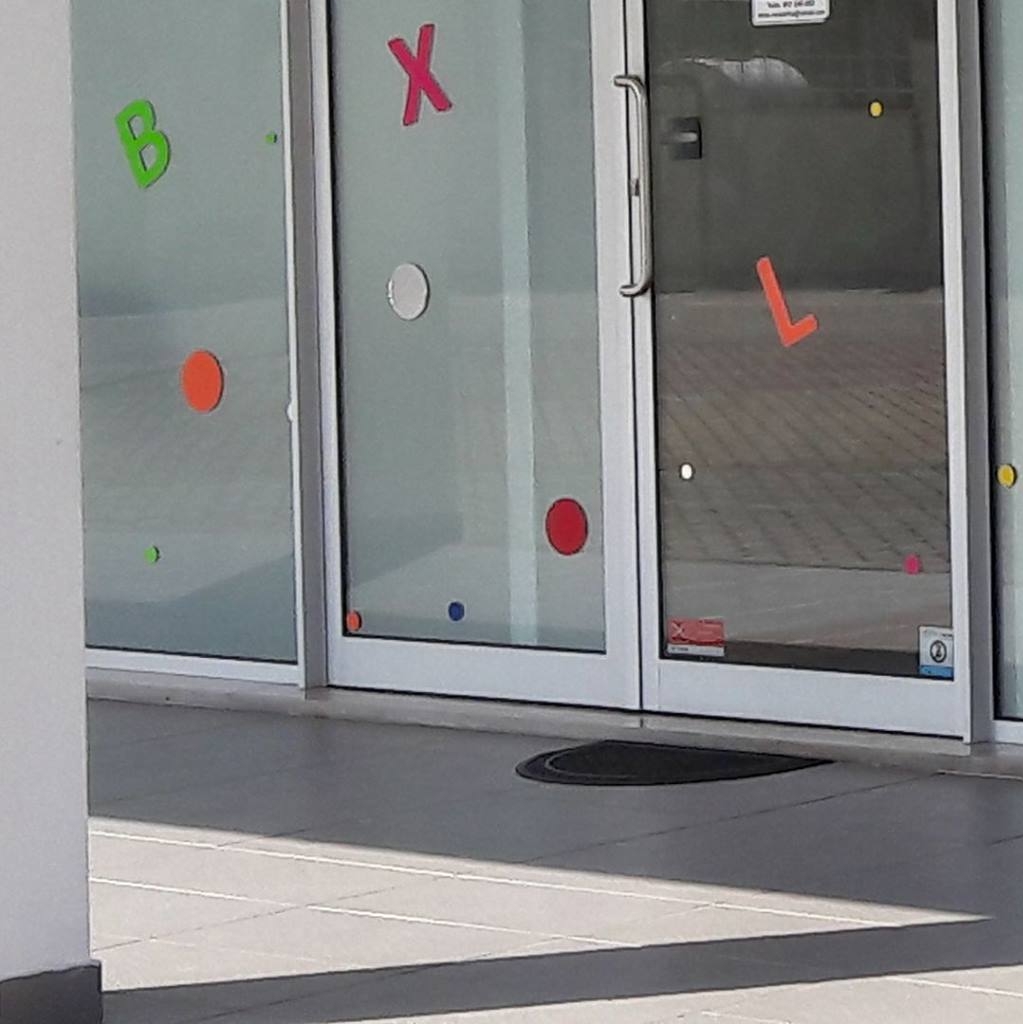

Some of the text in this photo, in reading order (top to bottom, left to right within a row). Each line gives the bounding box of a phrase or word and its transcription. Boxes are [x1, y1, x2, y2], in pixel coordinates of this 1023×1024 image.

[387, 23, 452, 126] X
[115, 99, 171, 189] B
[757, 257, 818, 346] L
